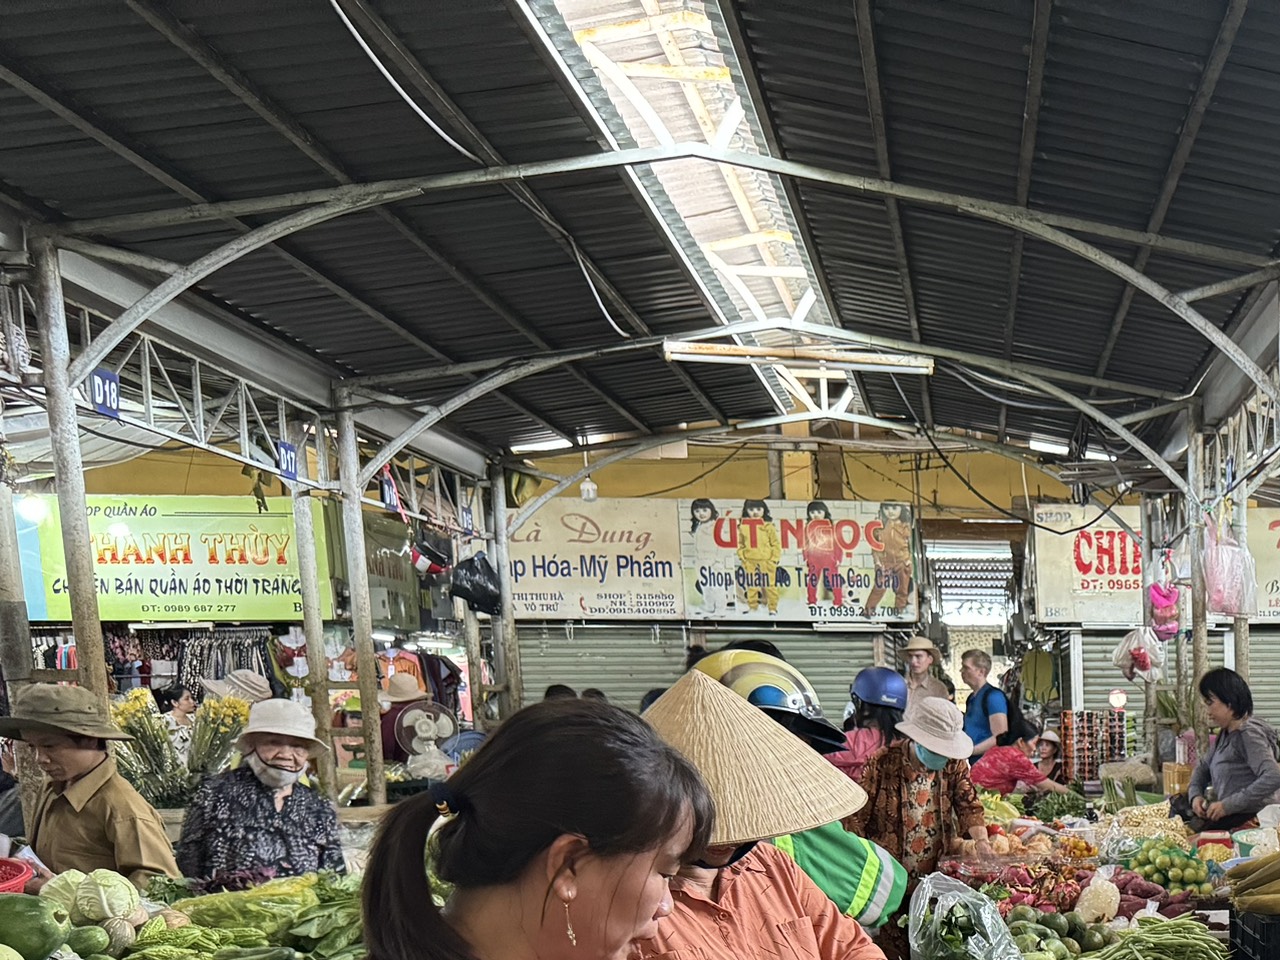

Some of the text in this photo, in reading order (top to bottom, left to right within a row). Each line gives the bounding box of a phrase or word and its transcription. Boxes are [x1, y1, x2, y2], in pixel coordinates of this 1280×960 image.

[93, 375, 118, 410] D18
[280, 452, 296, 474] D17
[85, 502, 157, 518] OP QUẦN ÁO
[90, 523, 291, 565] HANH THÙY
[560, 513, 652, 551] Dung
[780, 518, 885, 558] NGỌC
[616, 551, 673, 578] Phẩm
[700, 565, 733, 590] Shop
[847, 567, 870, 588] Cao
[52, 572, 110, 595] CHÊN
[115, 572, 144, 595] BÁN
[149, 568, 188, 597] QUẦN
[193, 572, 211, 596] ÁO
[215, 572, 248, 596] THỜI
[164, 604, 191, 613] 0989
[193, 604, 213, 613] 687
[217, 604, 237, 613] 277
